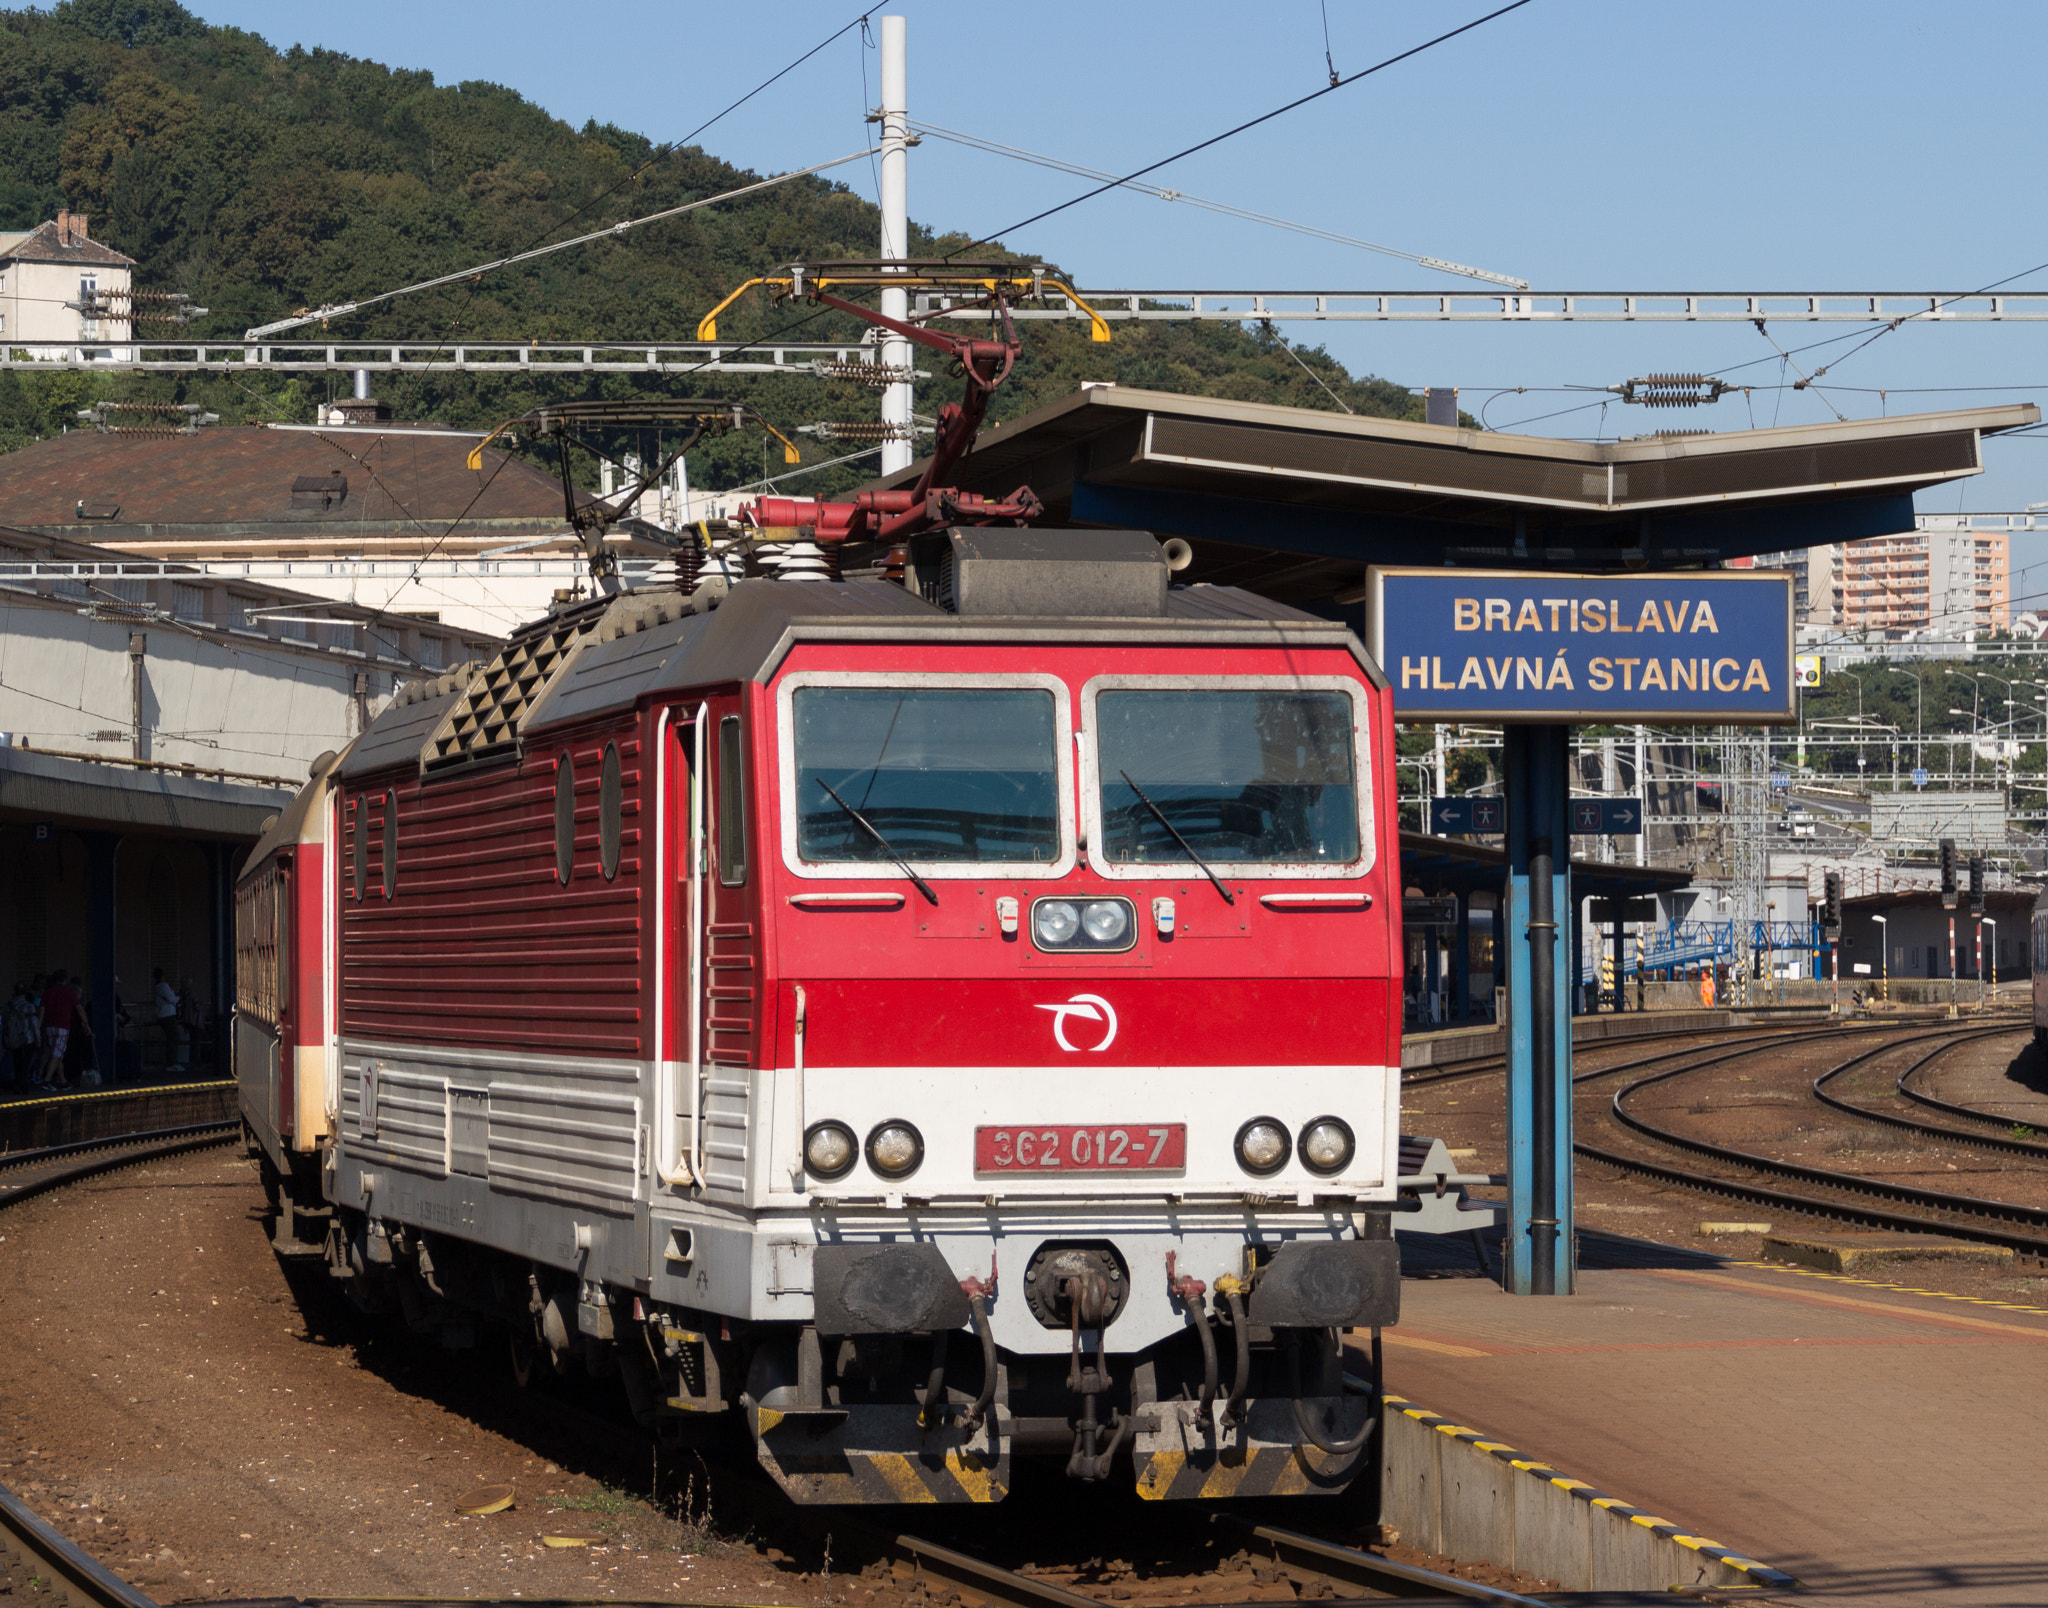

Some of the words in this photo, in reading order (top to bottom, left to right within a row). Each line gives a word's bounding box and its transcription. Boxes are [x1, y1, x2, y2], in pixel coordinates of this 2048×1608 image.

[1454, 598, 1719, 633] BRATISLAVA
[1402, 648, 1575, 691] HLAVNÁ
[1588, 657, 1771, 693] STANICA
[36, 825, 48, 839] B
[993, 1131, 1061, 1166] 362
[1071, 1129, 1169, 1165] 012-7
